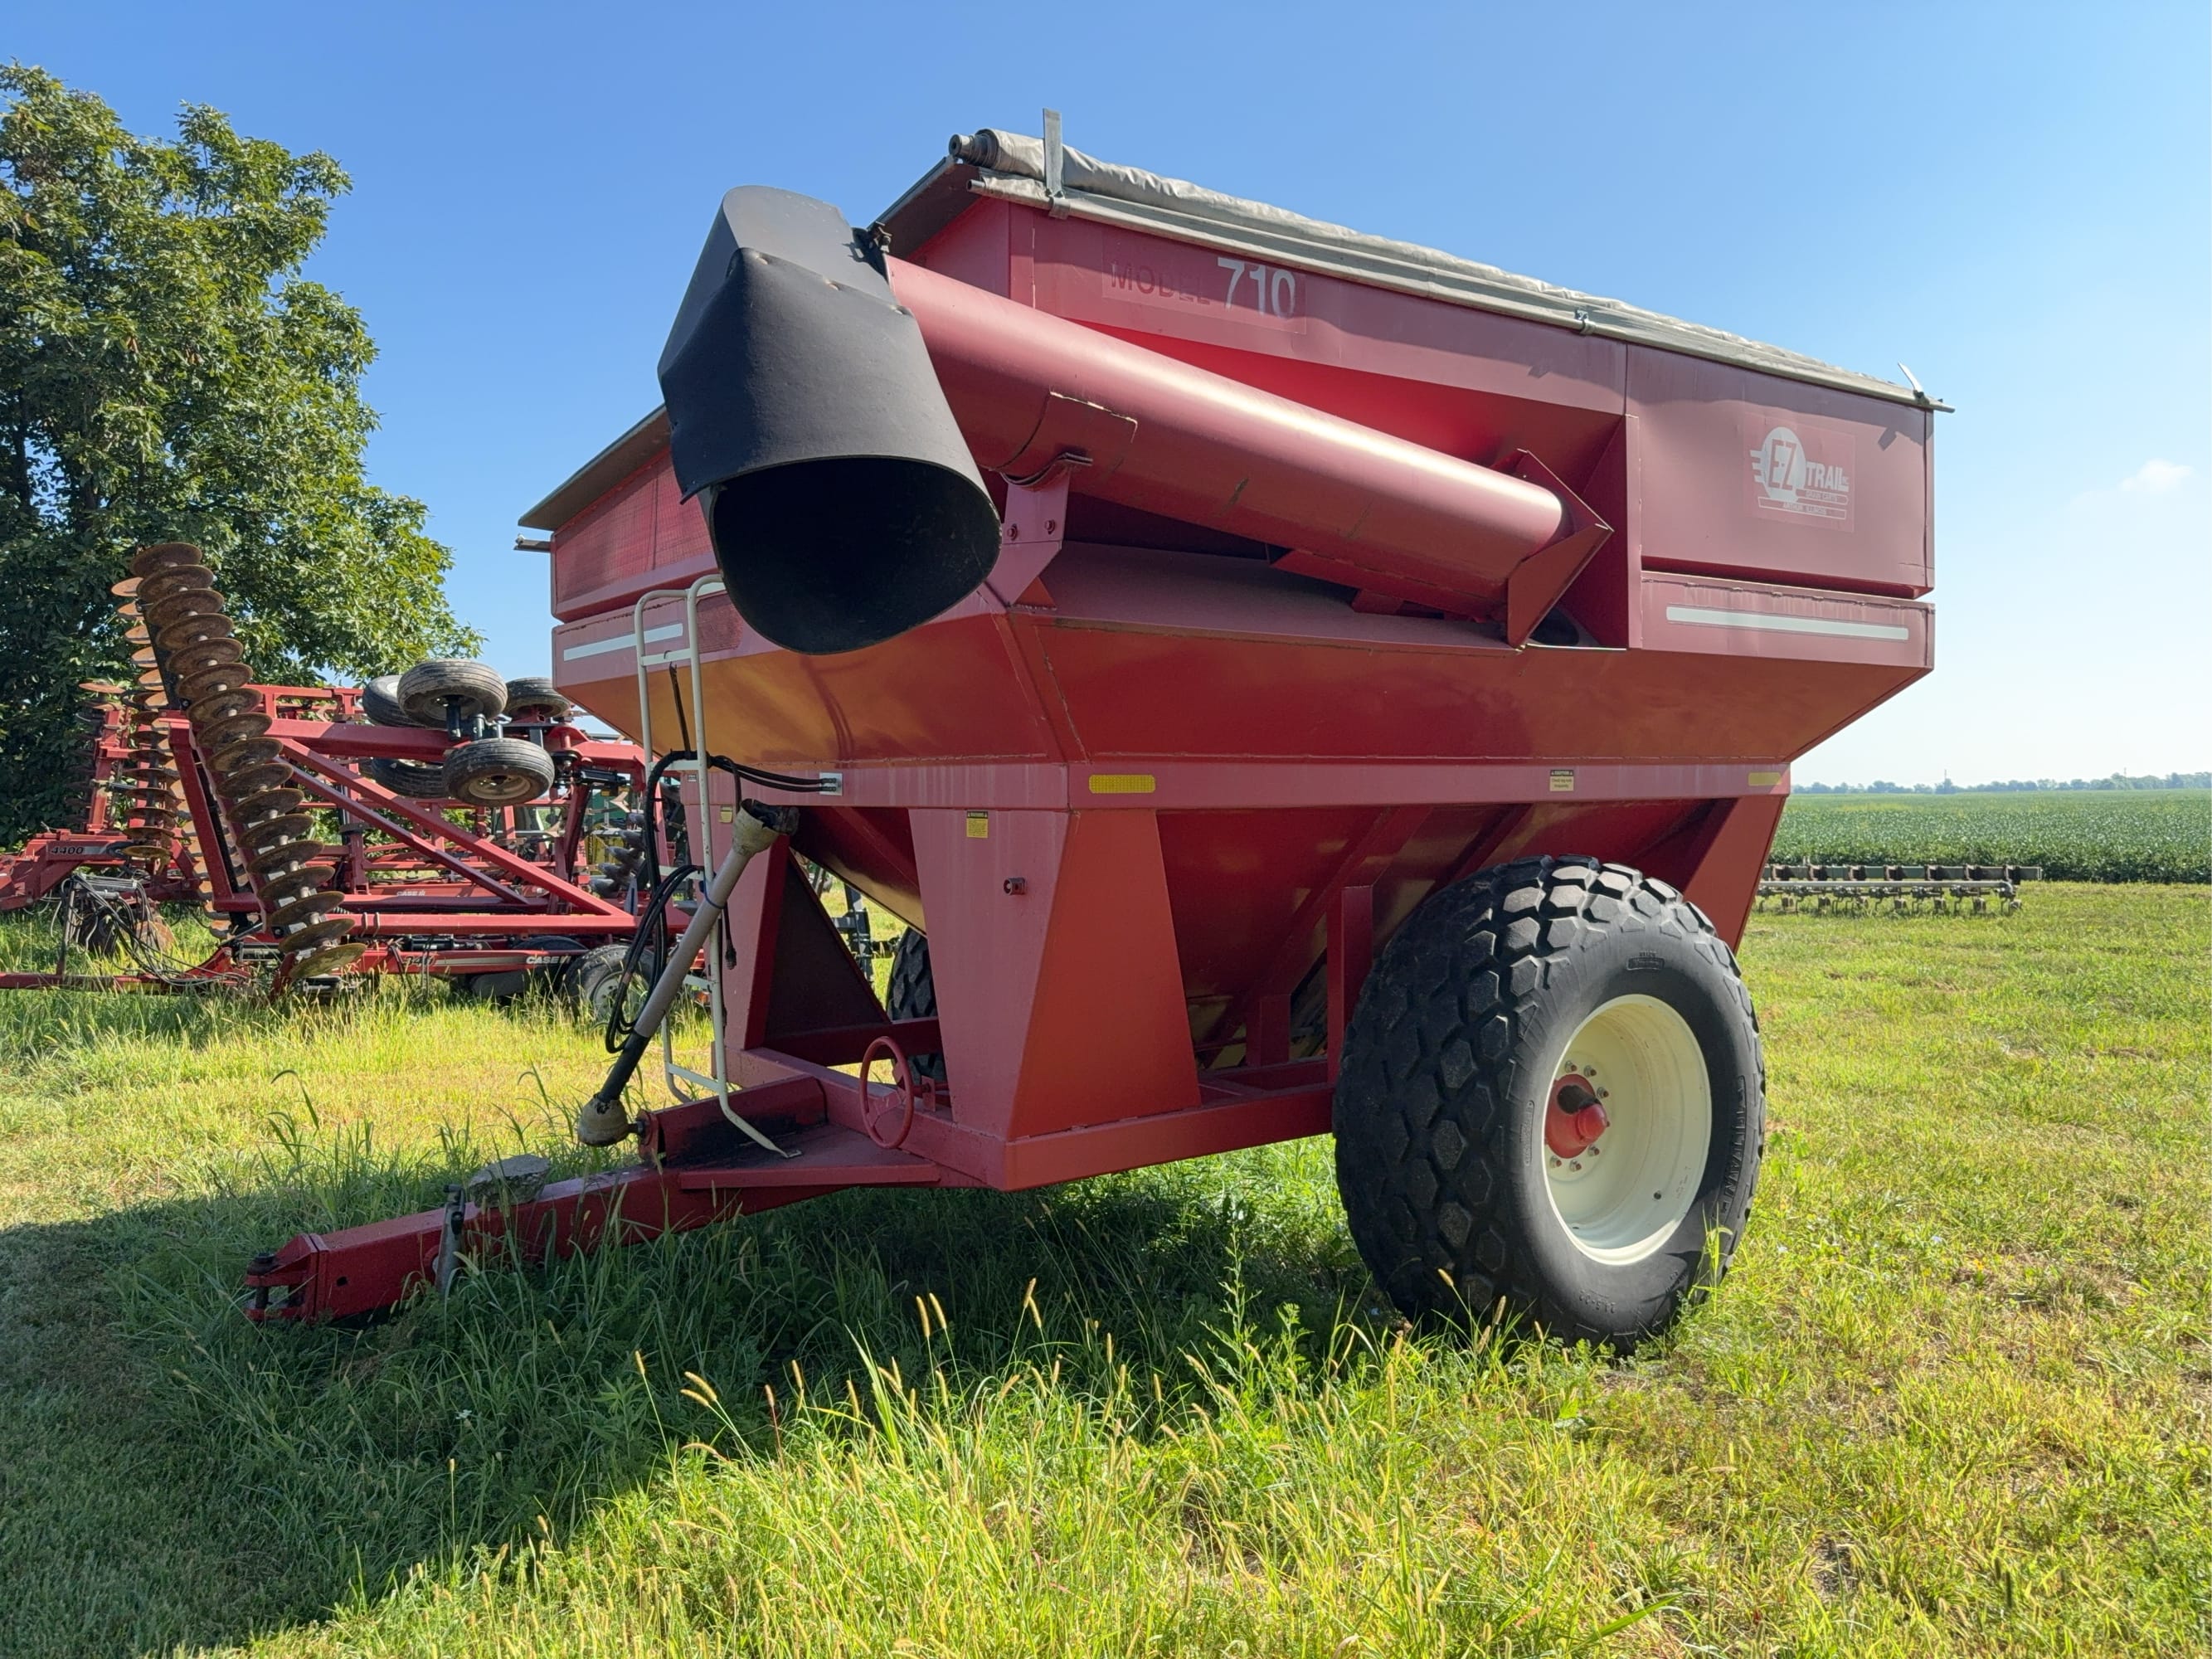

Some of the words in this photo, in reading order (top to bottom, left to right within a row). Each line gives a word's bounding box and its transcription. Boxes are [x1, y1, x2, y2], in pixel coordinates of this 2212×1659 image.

[1217, 256, 1296, 319] 710
[1806, 460, 1850, 492] TRAIL
[51, 846, 84, 854] 4400
[526, 956, 560, 964] CASE
